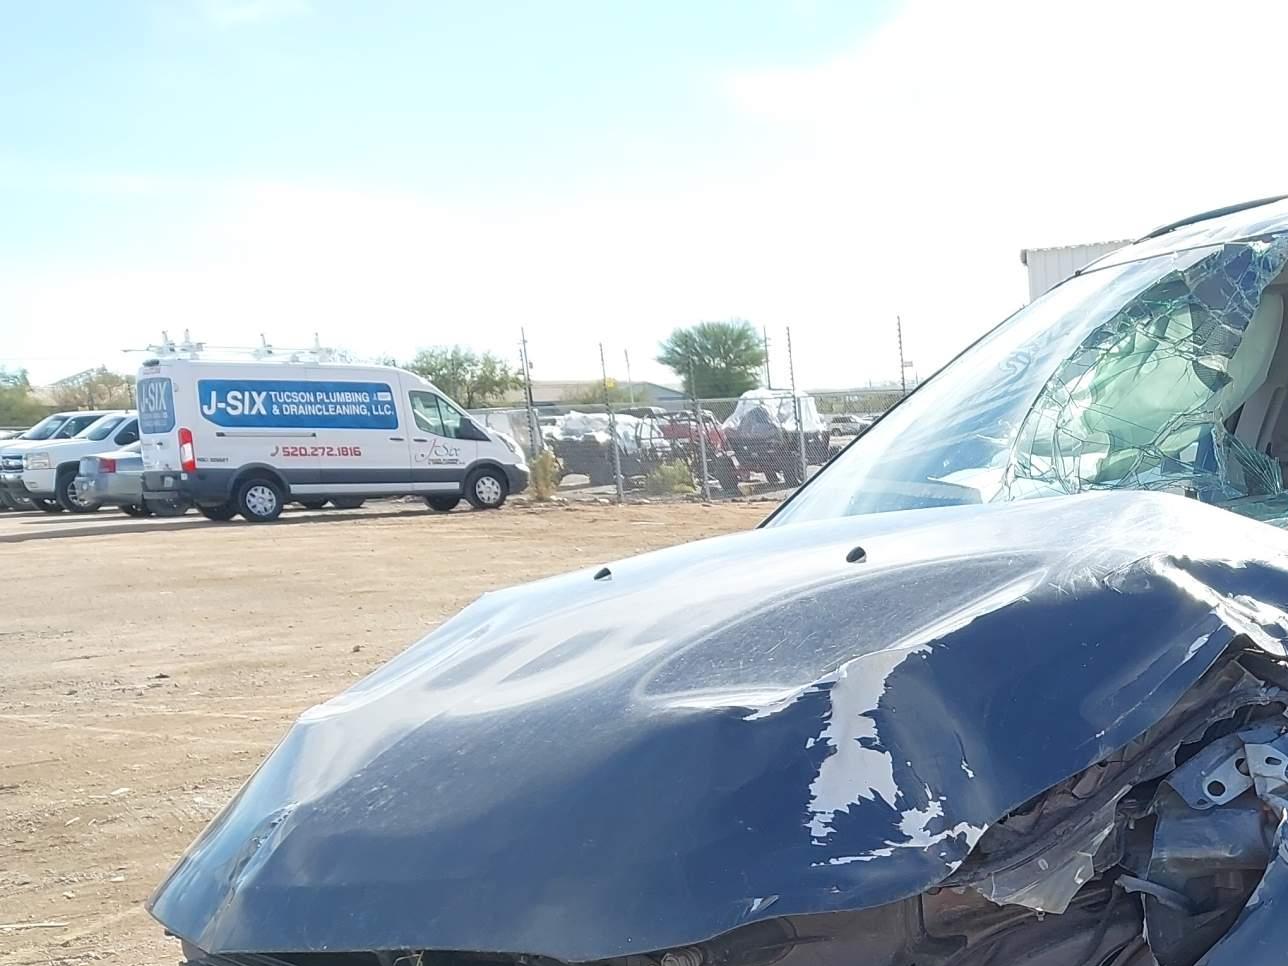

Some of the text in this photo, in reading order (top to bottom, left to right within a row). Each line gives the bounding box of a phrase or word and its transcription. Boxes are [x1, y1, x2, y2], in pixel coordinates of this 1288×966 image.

[141, 382, 168, 412] J-SIX
[269, 391, 315, 403] TUCSON
[317, 391, 370, 403] PLUMBING
[203, 391, 267, 416] J-SIX
[272, 404, 394, 416] & DRAINCLEANING, LLC.
[282, 446, 362, 457] 520.272.1816
